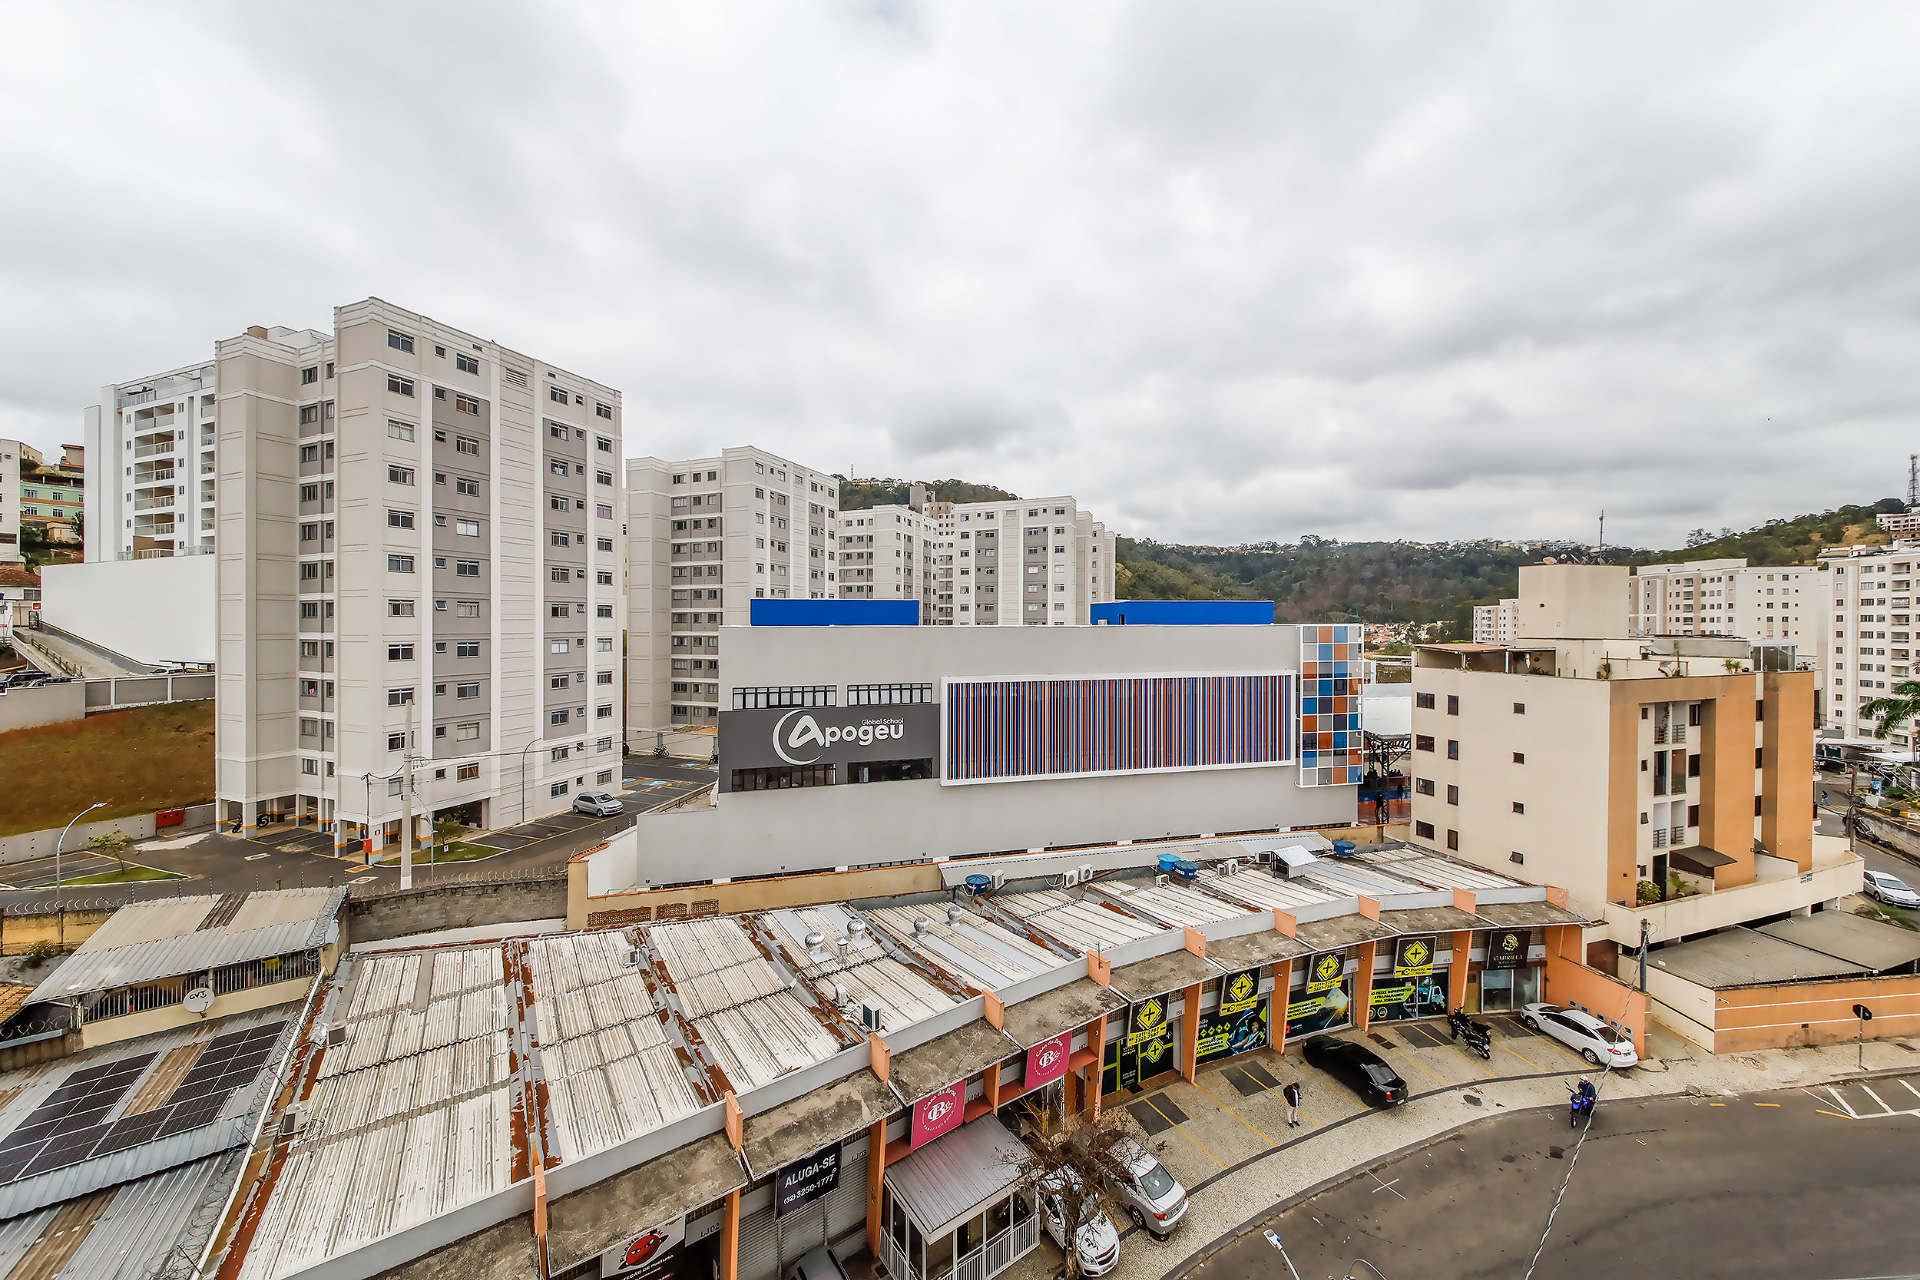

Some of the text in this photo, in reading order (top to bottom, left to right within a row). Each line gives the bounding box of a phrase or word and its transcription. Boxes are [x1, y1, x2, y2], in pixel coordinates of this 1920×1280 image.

[787, 714, 904, 748] Apogeu
[189, 990, 207, 1000] GVT
[1035, 1044, 1048, 1057] Casa
[923, 1095, 937, 1111] Casa
[784, 1154, 836, 1188] ALUGA-SE
[783, 1174, 834, 1205] (32) 3250-1777
